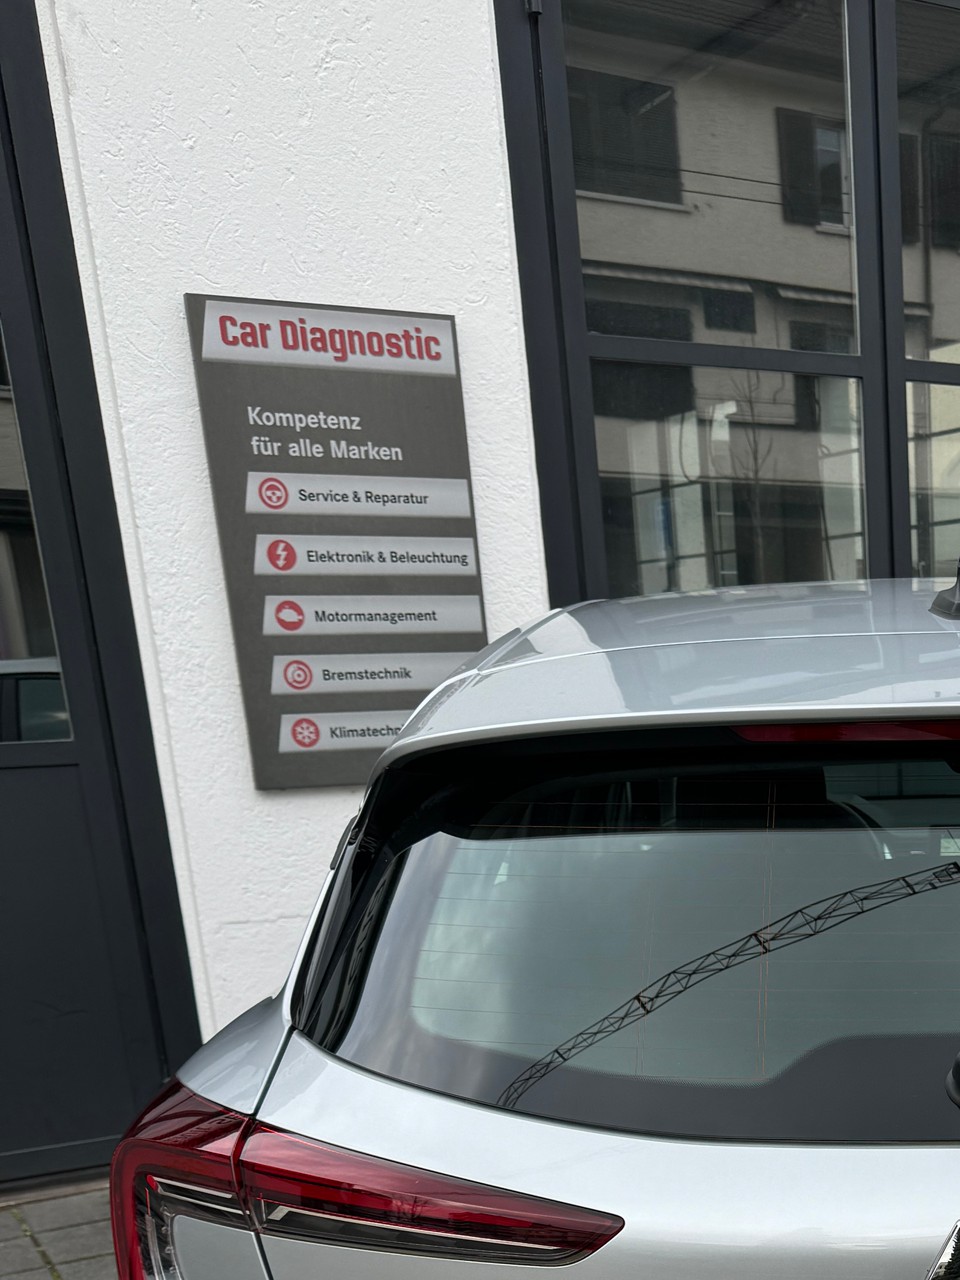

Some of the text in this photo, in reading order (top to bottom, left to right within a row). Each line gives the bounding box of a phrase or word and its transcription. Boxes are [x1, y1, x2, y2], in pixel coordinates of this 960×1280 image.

[218, 314, 442, 362] Car Diagnostic
[246, 405, 362, 433] Kompetenz
[251, 436, 403, 462] für alle Marken
[298, 488, 429, 508] Service & Reparatur
[306, 550, 469, 568] Elektronik & Beleuchtung
[314, 609, 438, 627] Motormanagement
[322, 666, 413, 683] Bremstechnik
[329, 724, 403, 739] Klimatechn
